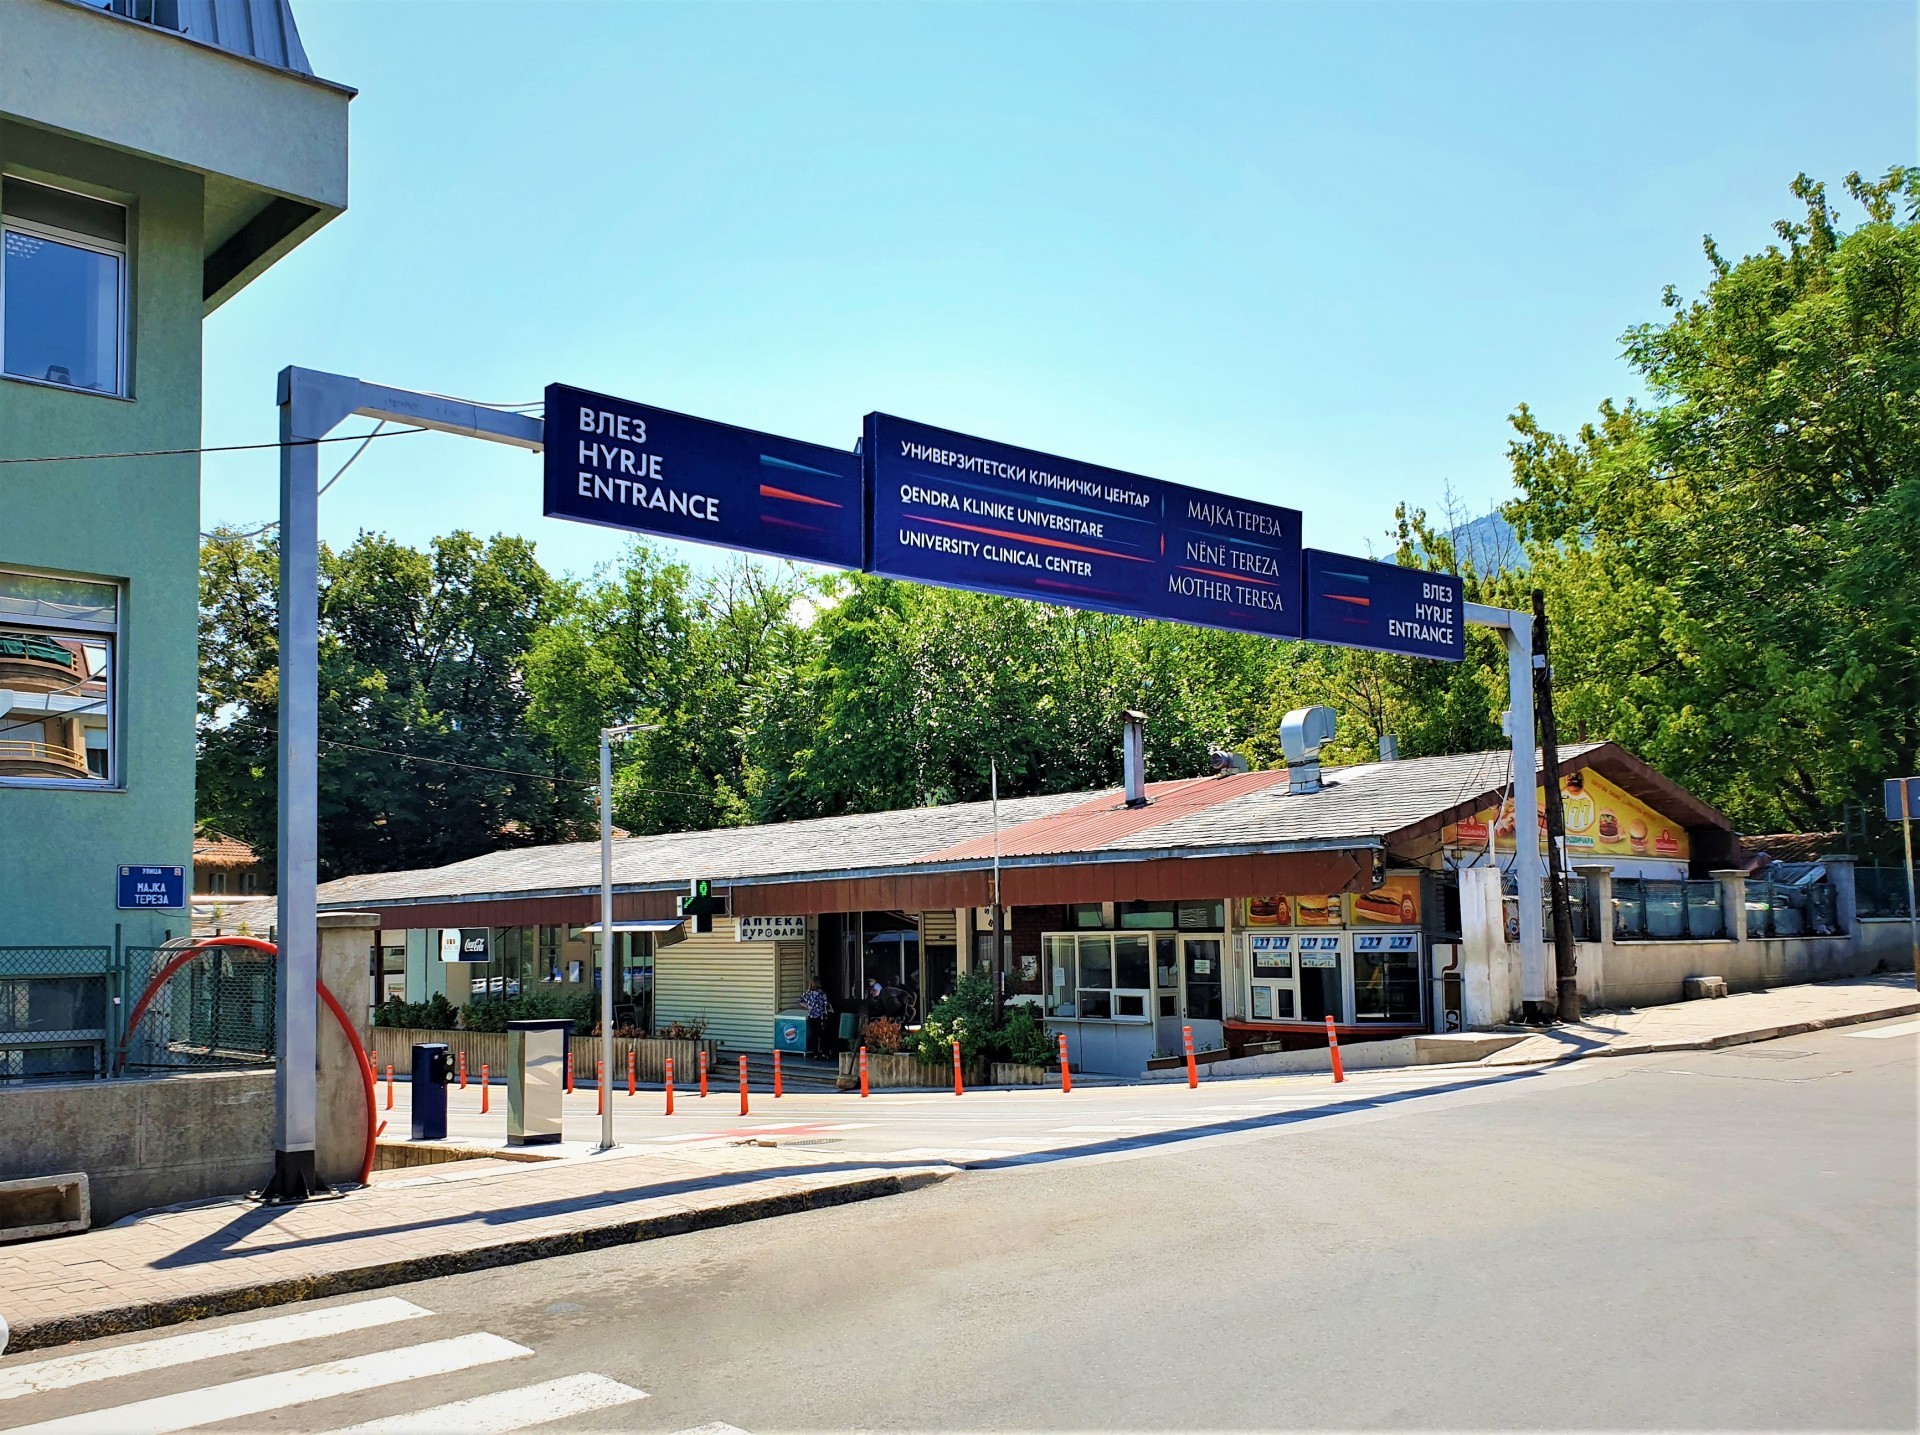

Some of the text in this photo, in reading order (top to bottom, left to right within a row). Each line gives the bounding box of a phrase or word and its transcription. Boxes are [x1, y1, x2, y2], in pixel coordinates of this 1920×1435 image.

[579, 407, 647, 444] ВЛЕЗ
[579, 440, 663, 481] HYRJE
[901, 440, 1151, 509] УНИВЕРЗИТЕТСКИ КЛИНИЧКИ ЦЕНТАР
[578, 471, 720, 522] ENTRANCE
[900, 485, 1105, 538] QENDRA KLINIKE UNIVERSITARE
[1187, 501, 1282, 538] МАЈКА ТЕРЕЗА
[899, 528, 1092, 577] UNIVERSITY CLINICAL CENTER
[1186, 541, 1279, 577] NËNË TEREZA
[1168, 575, 1284, 612] MOTHER TERESA
[1423, 582, 1453, 603] ВЛЕЗ
[1388, 619, 1454, 645] ENTRANCE
[1415, 603, 1453, 625] HYRJE
[134, 894, 169, 905] ТЕРЕЗА
[137, 882, 166, 893] МАЈКА
[743, 917, 804, 926] АПТЕКА
